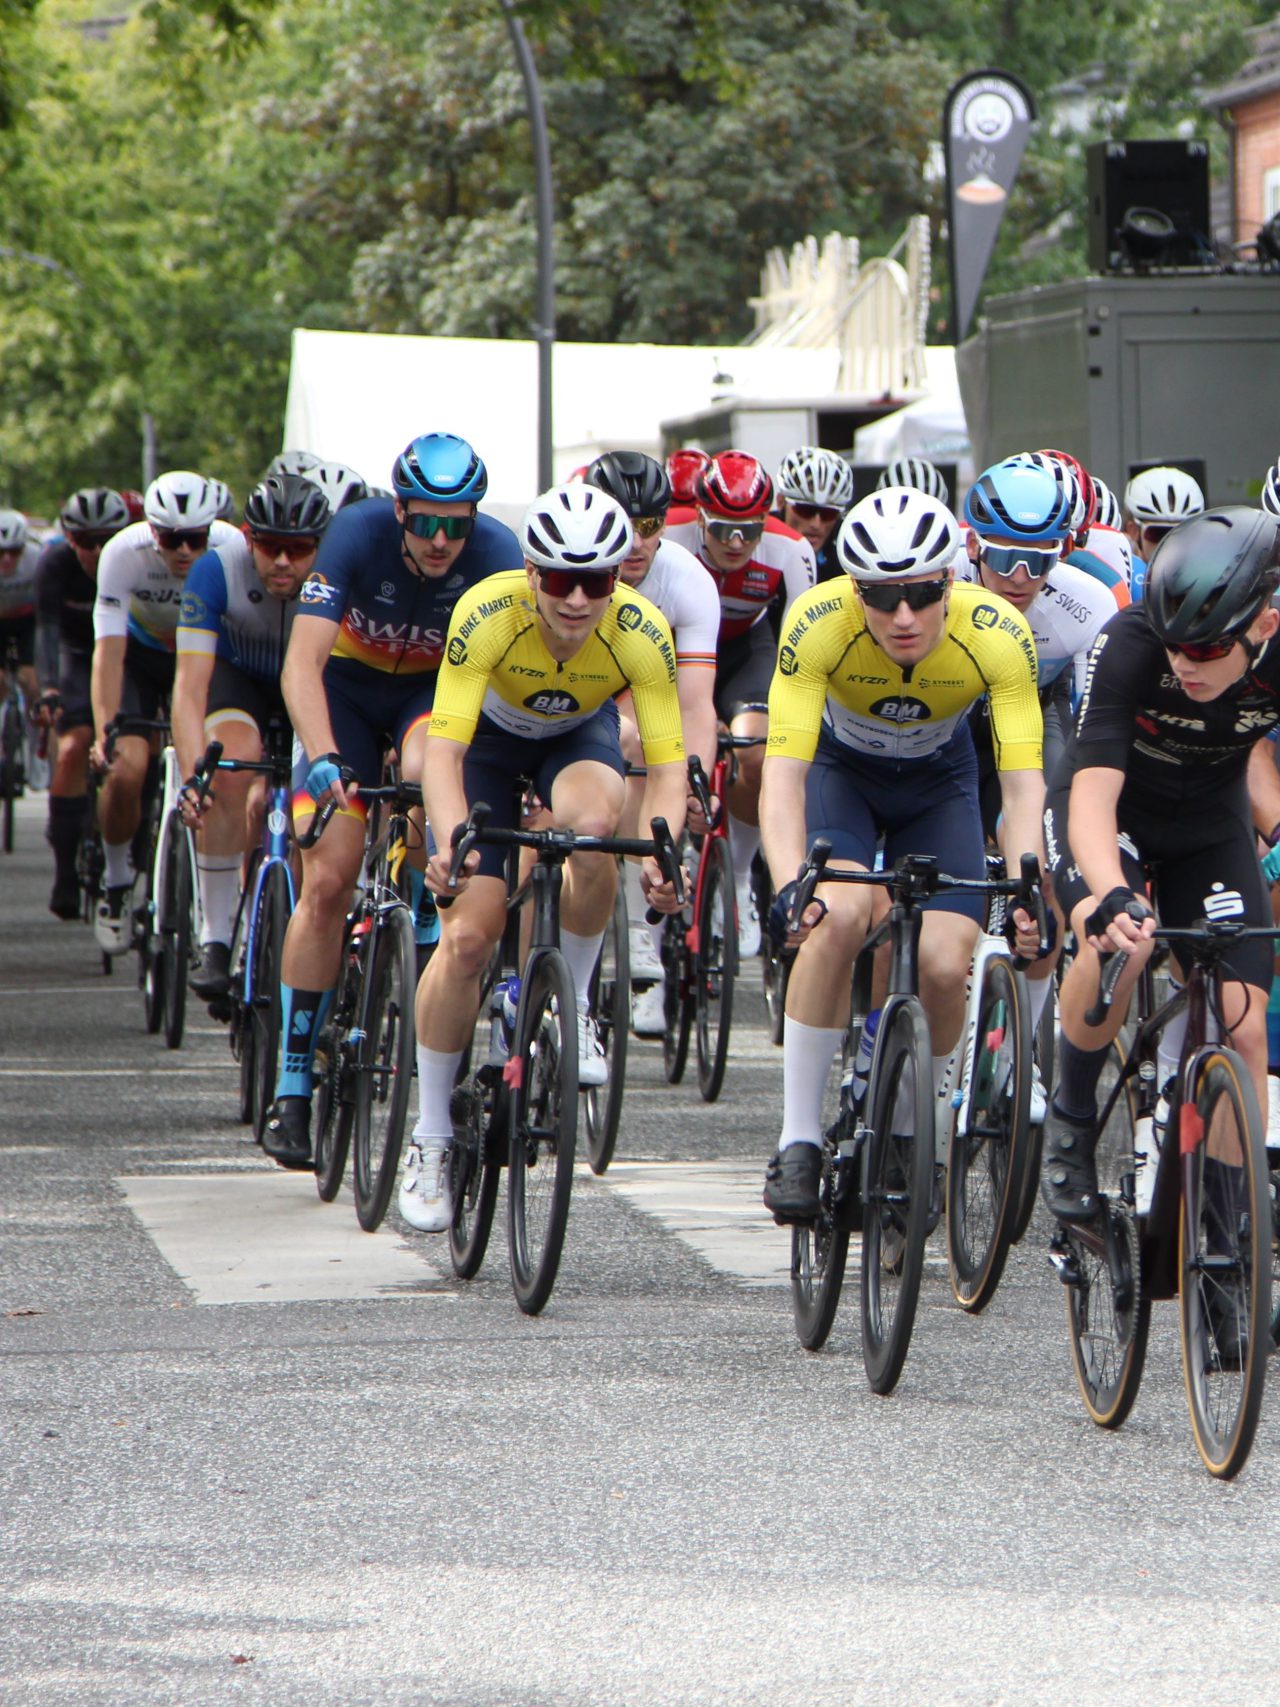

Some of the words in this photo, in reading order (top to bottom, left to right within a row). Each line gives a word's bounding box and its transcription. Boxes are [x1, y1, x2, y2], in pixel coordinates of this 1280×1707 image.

[459, 613, 480, 639] BIKE
[480, 594, 515, 620] MARKET
[788, 619, 809, 646] BIKE
[805, 597, 844, 624] MARKET
[1055, 593, 1092, 623] SWISS
[351, 607, 443, 645] SWIS
[619, 605, 641, 628] BM
[640, 620, 664, 645] BIKE
[659, 641, 676, 684] MARKET
[974, 608, 997, 626] BM
[998, 617, 1022, 639] BIKE
[1020, 637, 1039, 683] MARKET
[509, 665, 546, 679] KYZR
[848, 674, 889, 685] KYZR
[532, 696, 571, 710] BM
[880, 702, 921, 718] BM
